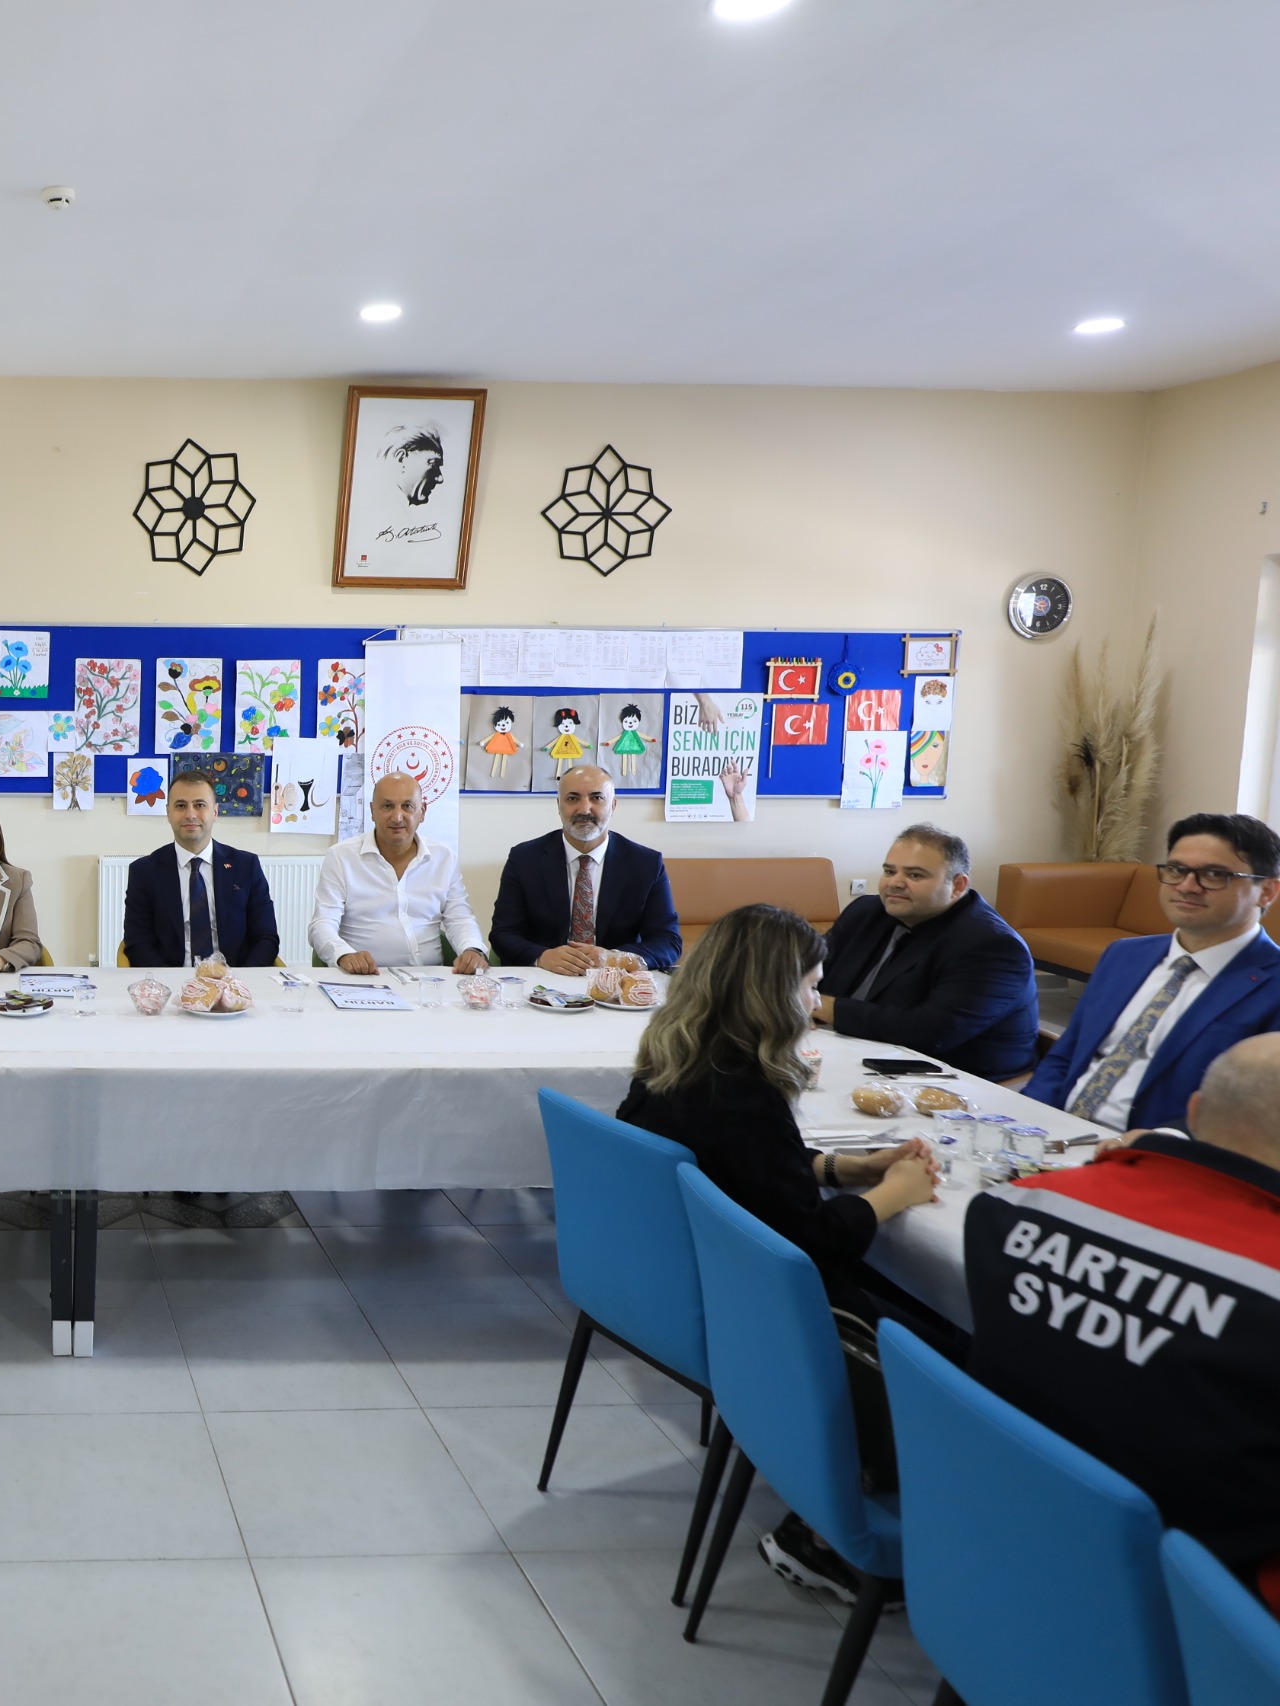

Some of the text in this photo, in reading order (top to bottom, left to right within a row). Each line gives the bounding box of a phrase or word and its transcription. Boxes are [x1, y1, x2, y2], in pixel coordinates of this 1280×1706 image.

[674, 701, 698, 725] BİZ
[673, 728, 720, 752] SENİN
[725, 727, 756, 754] İÇİN
[1003, 1220, 1238, 1340] BARTIN
[1008, 1271, 1175, 1368] SYDV
